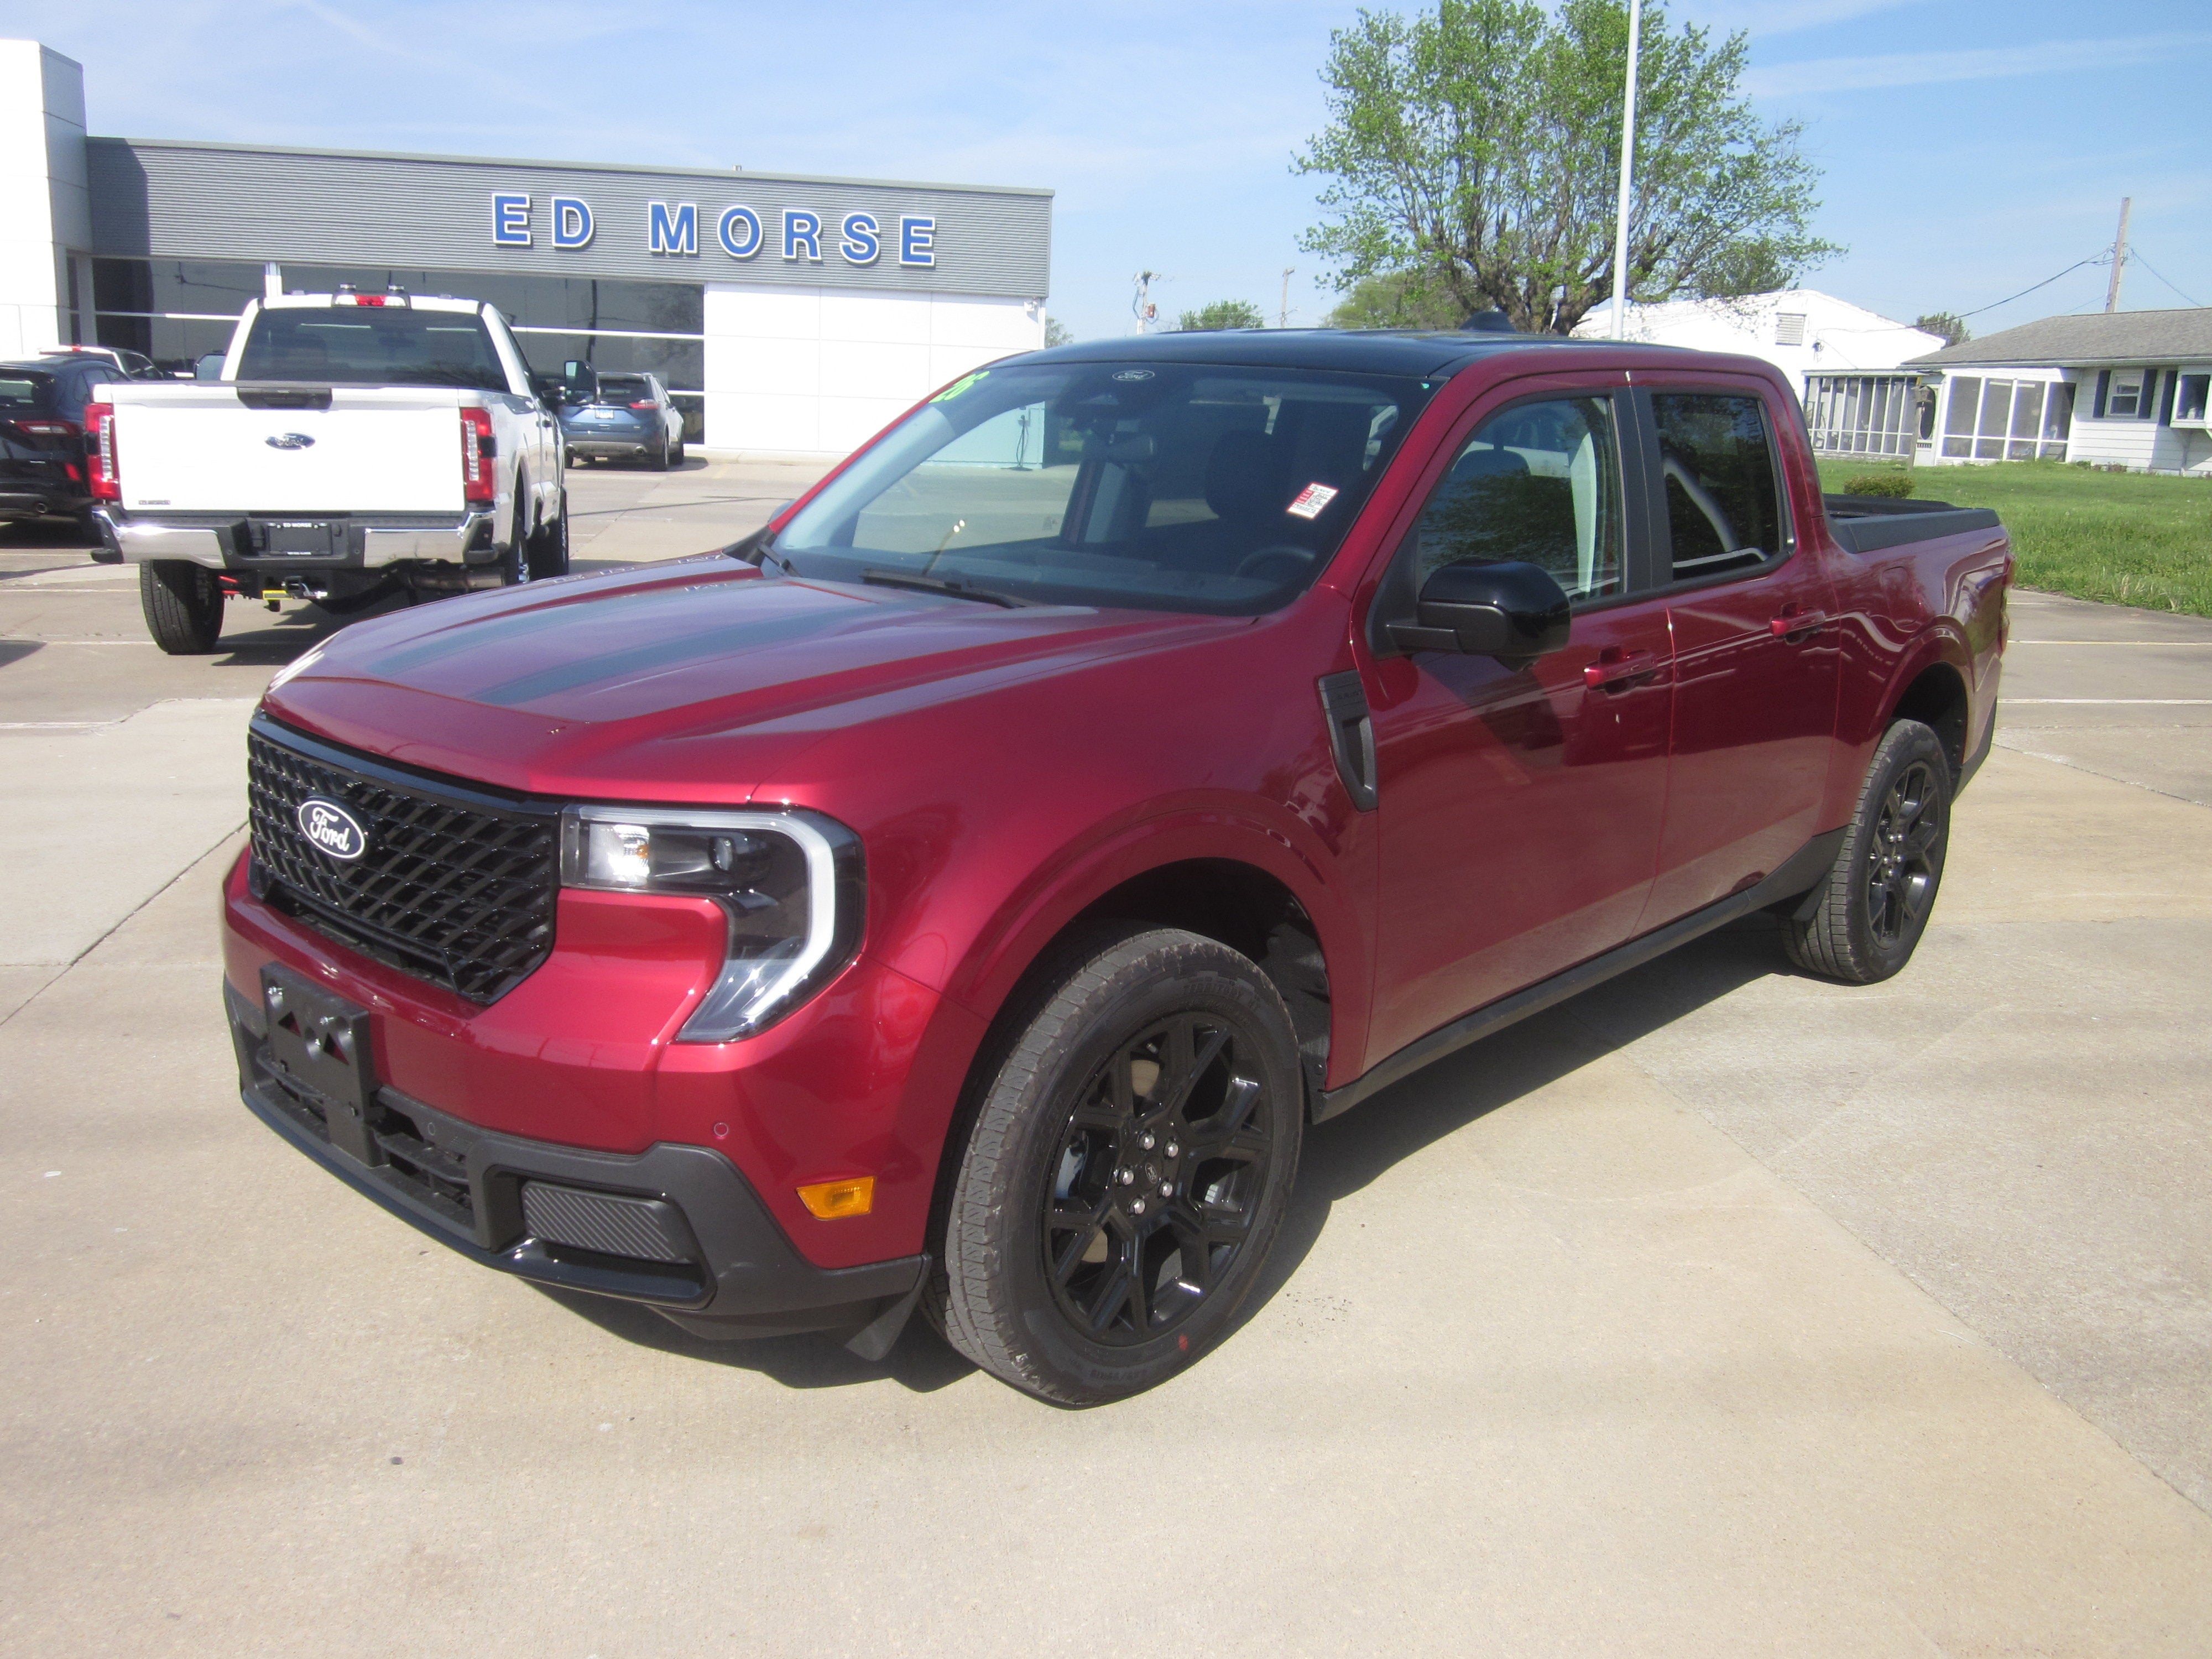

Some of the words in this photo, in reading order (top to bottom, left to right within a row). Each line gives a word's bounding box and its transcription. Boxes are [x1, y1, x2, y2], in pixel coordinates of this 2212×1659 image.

[492, 193, 594, 248] ED
[648, 201, 936, 265] MORSE
[310, 807, 350, 852] Ford
